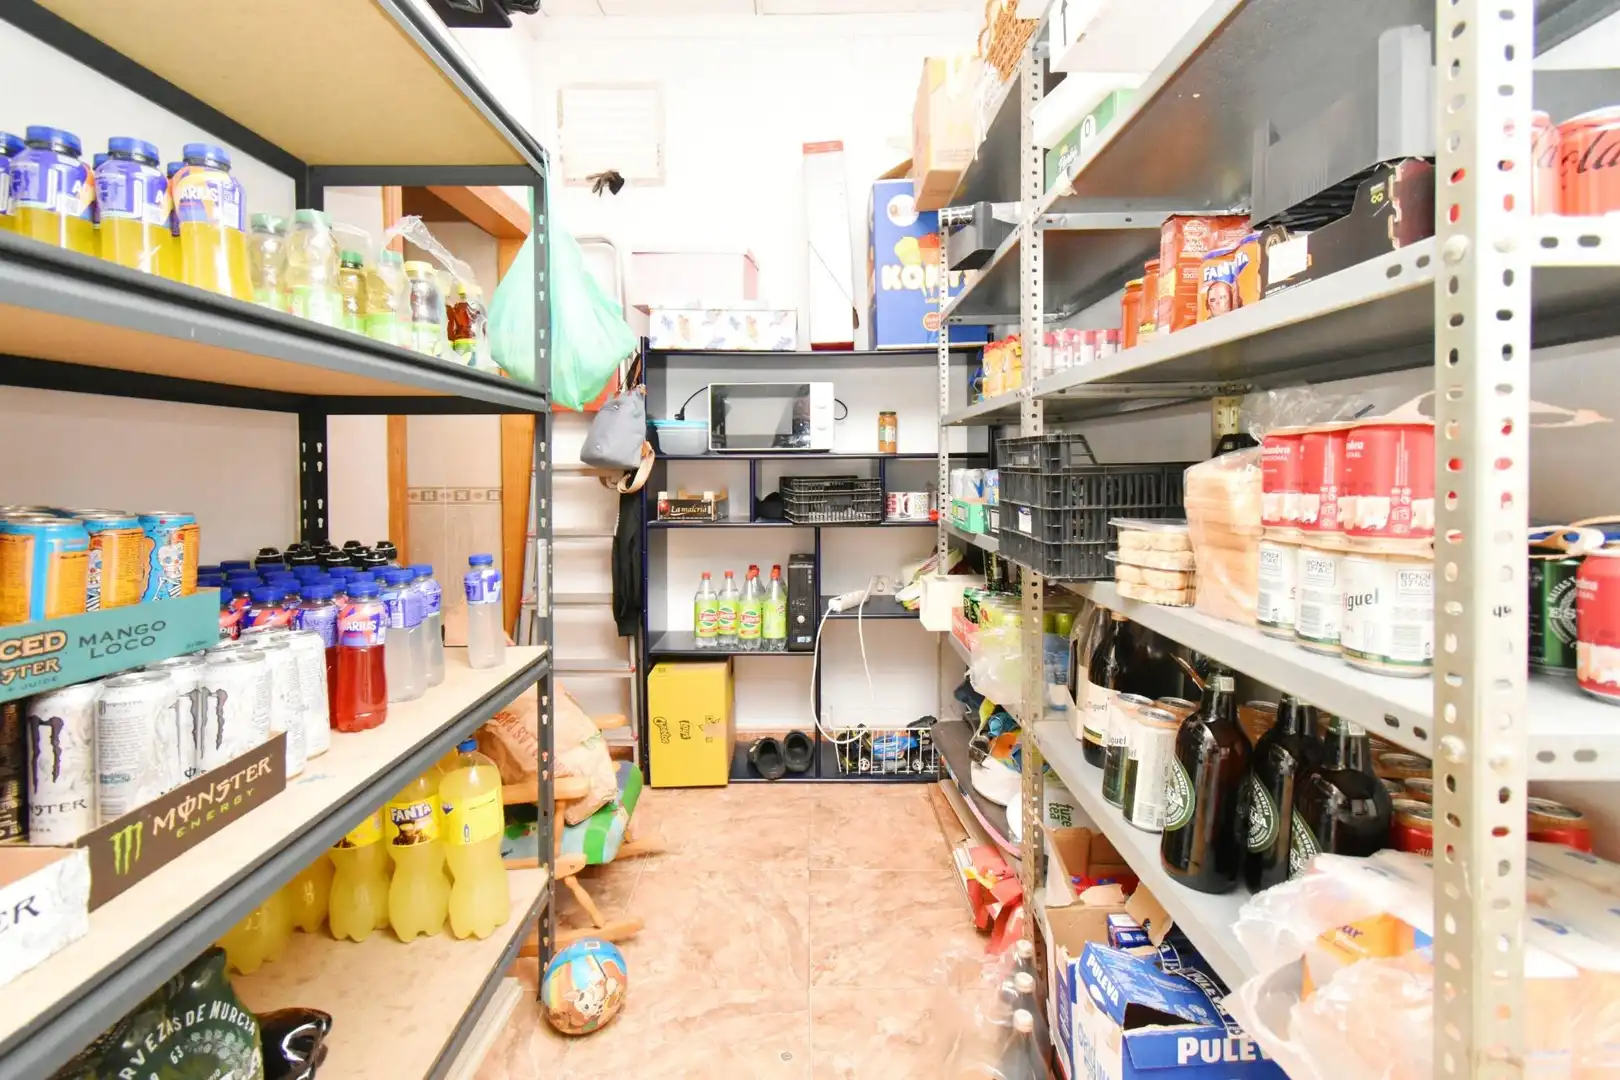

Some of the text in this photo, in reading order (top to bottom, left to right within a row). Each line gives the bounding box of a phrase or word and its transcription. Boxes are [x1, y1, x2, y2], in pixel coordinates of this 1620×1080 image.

[1203, 252, 1249, 283] FANTA
[1342, 587, 1379, 613] iguel
[79, 620, 167, 649] MANGO
[90, 636, 157, 660] LOCO
[176, 787, 254, 839] ENERGY
[390, 801, 432, 822] FANTA
[1048, 802, 1060, 820] tea
[1060, 804, 1075, 828] fuze
[1086, 953, 1120, 1007] PULEVA
[184, 1002, 207, 1027] DE
[209, 1000, 256, 1037] MURCIA
